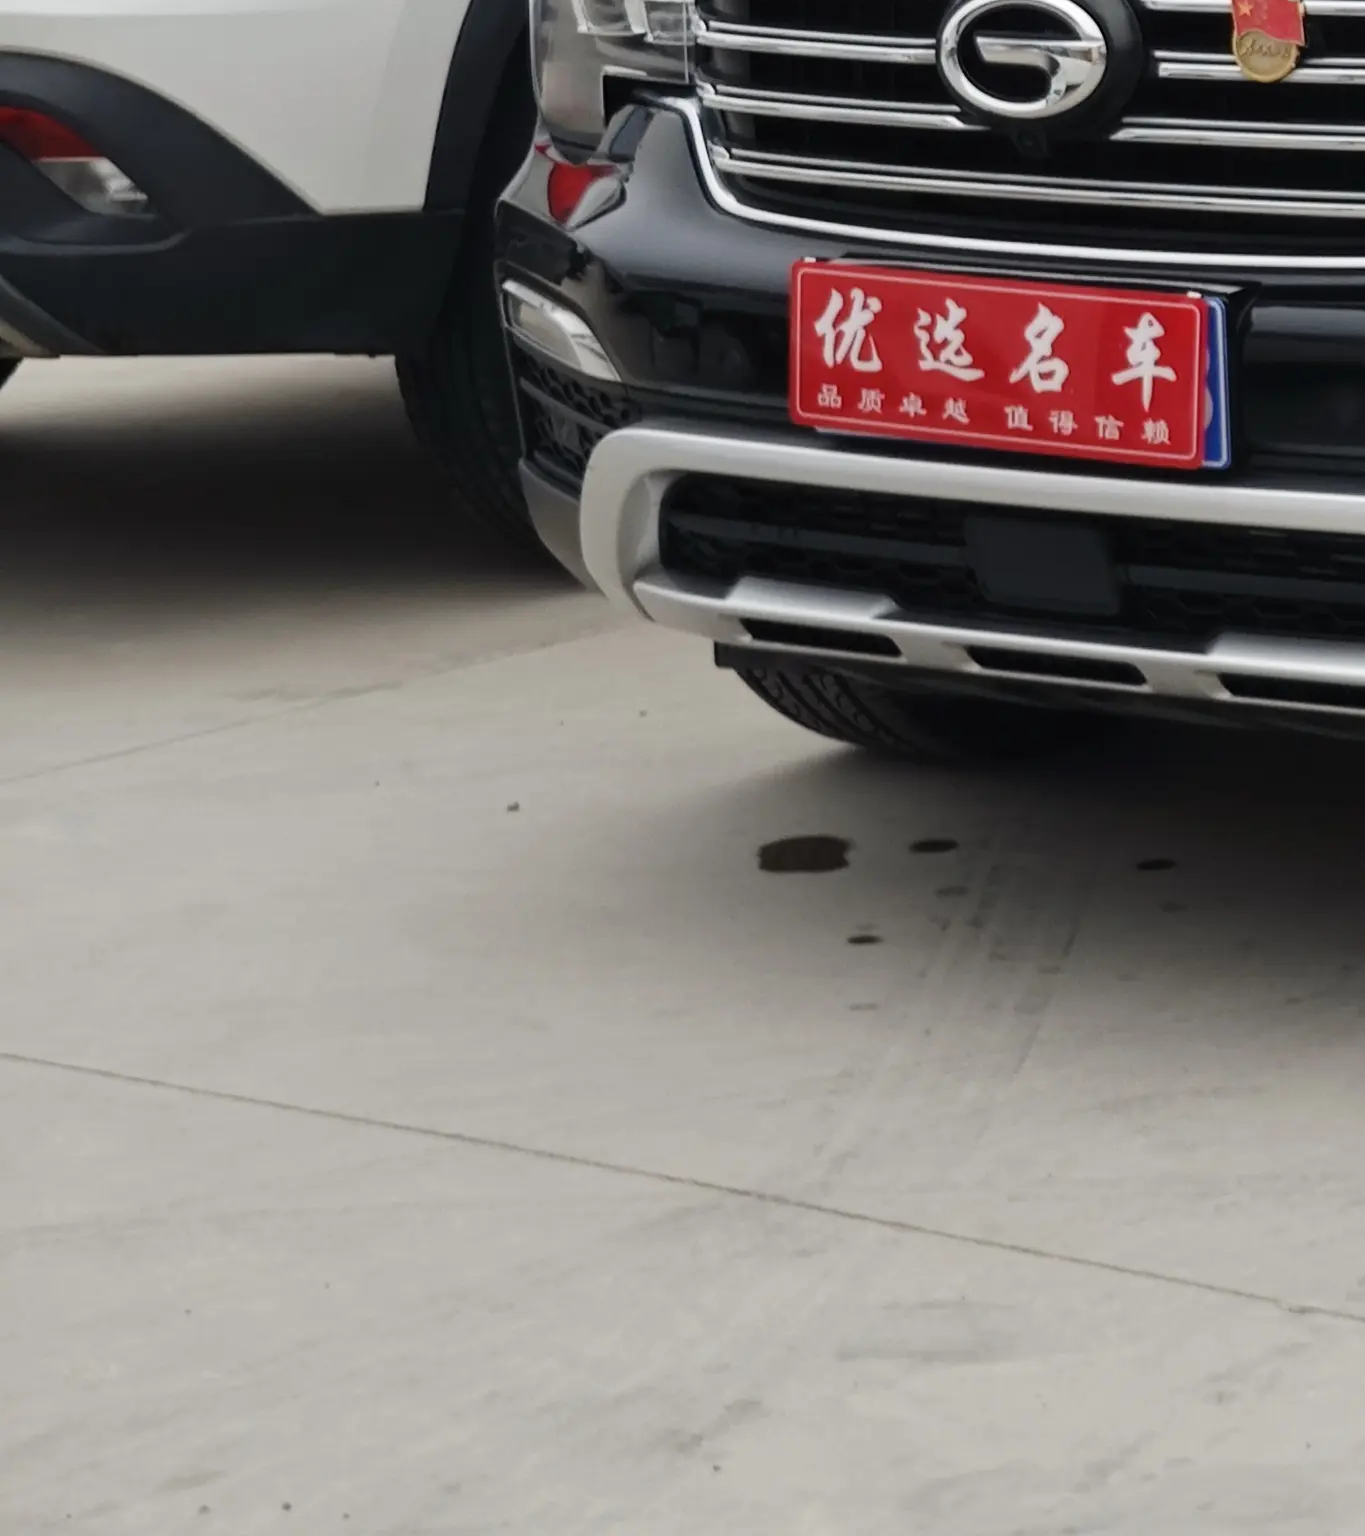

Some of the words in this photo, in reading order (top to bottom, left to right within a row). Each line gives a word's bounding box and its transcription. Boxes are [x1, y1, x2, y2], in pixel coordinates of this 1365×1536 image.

[814, 287, 1177, 412] 优选名车
[816, 383, 970, 425] 品质卓越
[1004, 406, 1172, 446] 值得信赖
